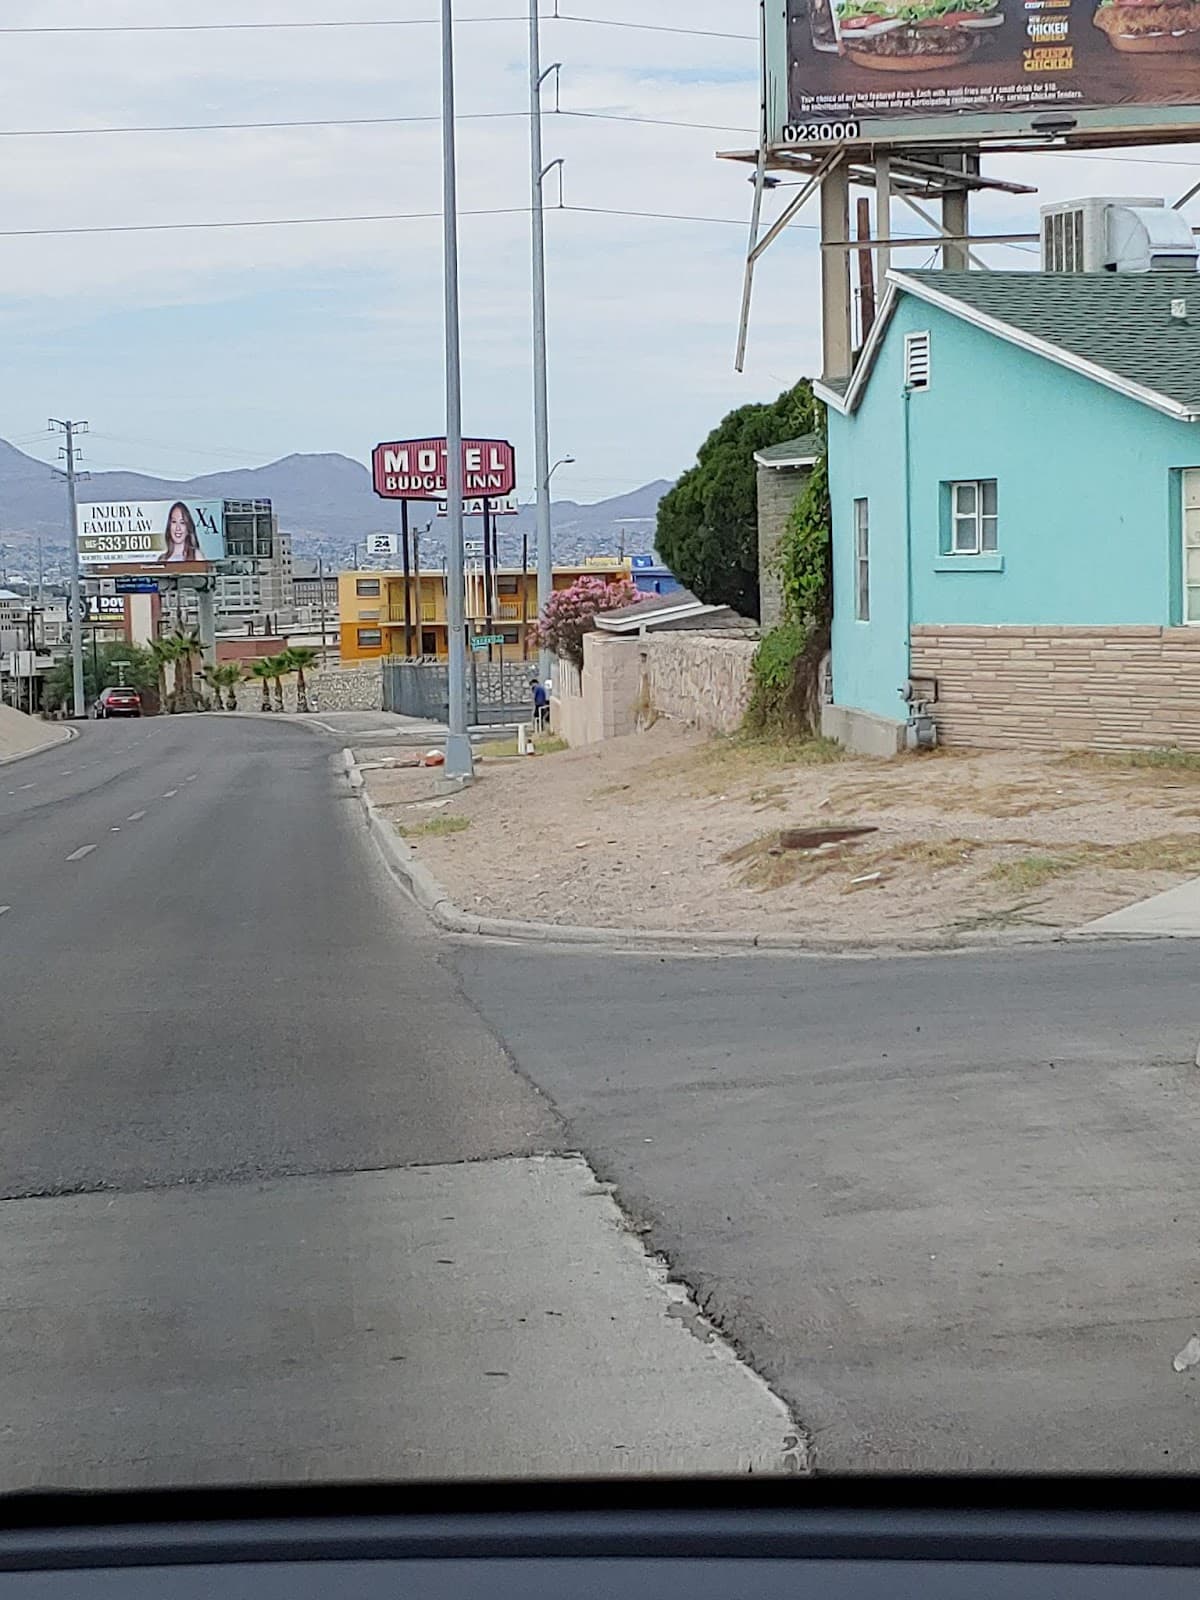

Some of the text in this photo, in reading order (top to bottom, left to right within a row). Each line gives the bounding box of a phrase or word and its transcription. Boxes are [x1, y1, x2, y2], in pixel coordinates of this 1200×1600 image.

[1027, 22, 1068, 36] CHICKEN
[1024, 58, 1072, 71] CHICKEN
[784, 122, 858, 143] 023000
[384, 448, 505, 473] MOEL
[386, 473, 500, 490] BUDGE INN
[92, 505, 144, 519] INJURY &
[438, 501, 514, 511] UAUL
[83, 520, 152, 534] FAMILY LAW
[375, 540, 390, 548] 24
